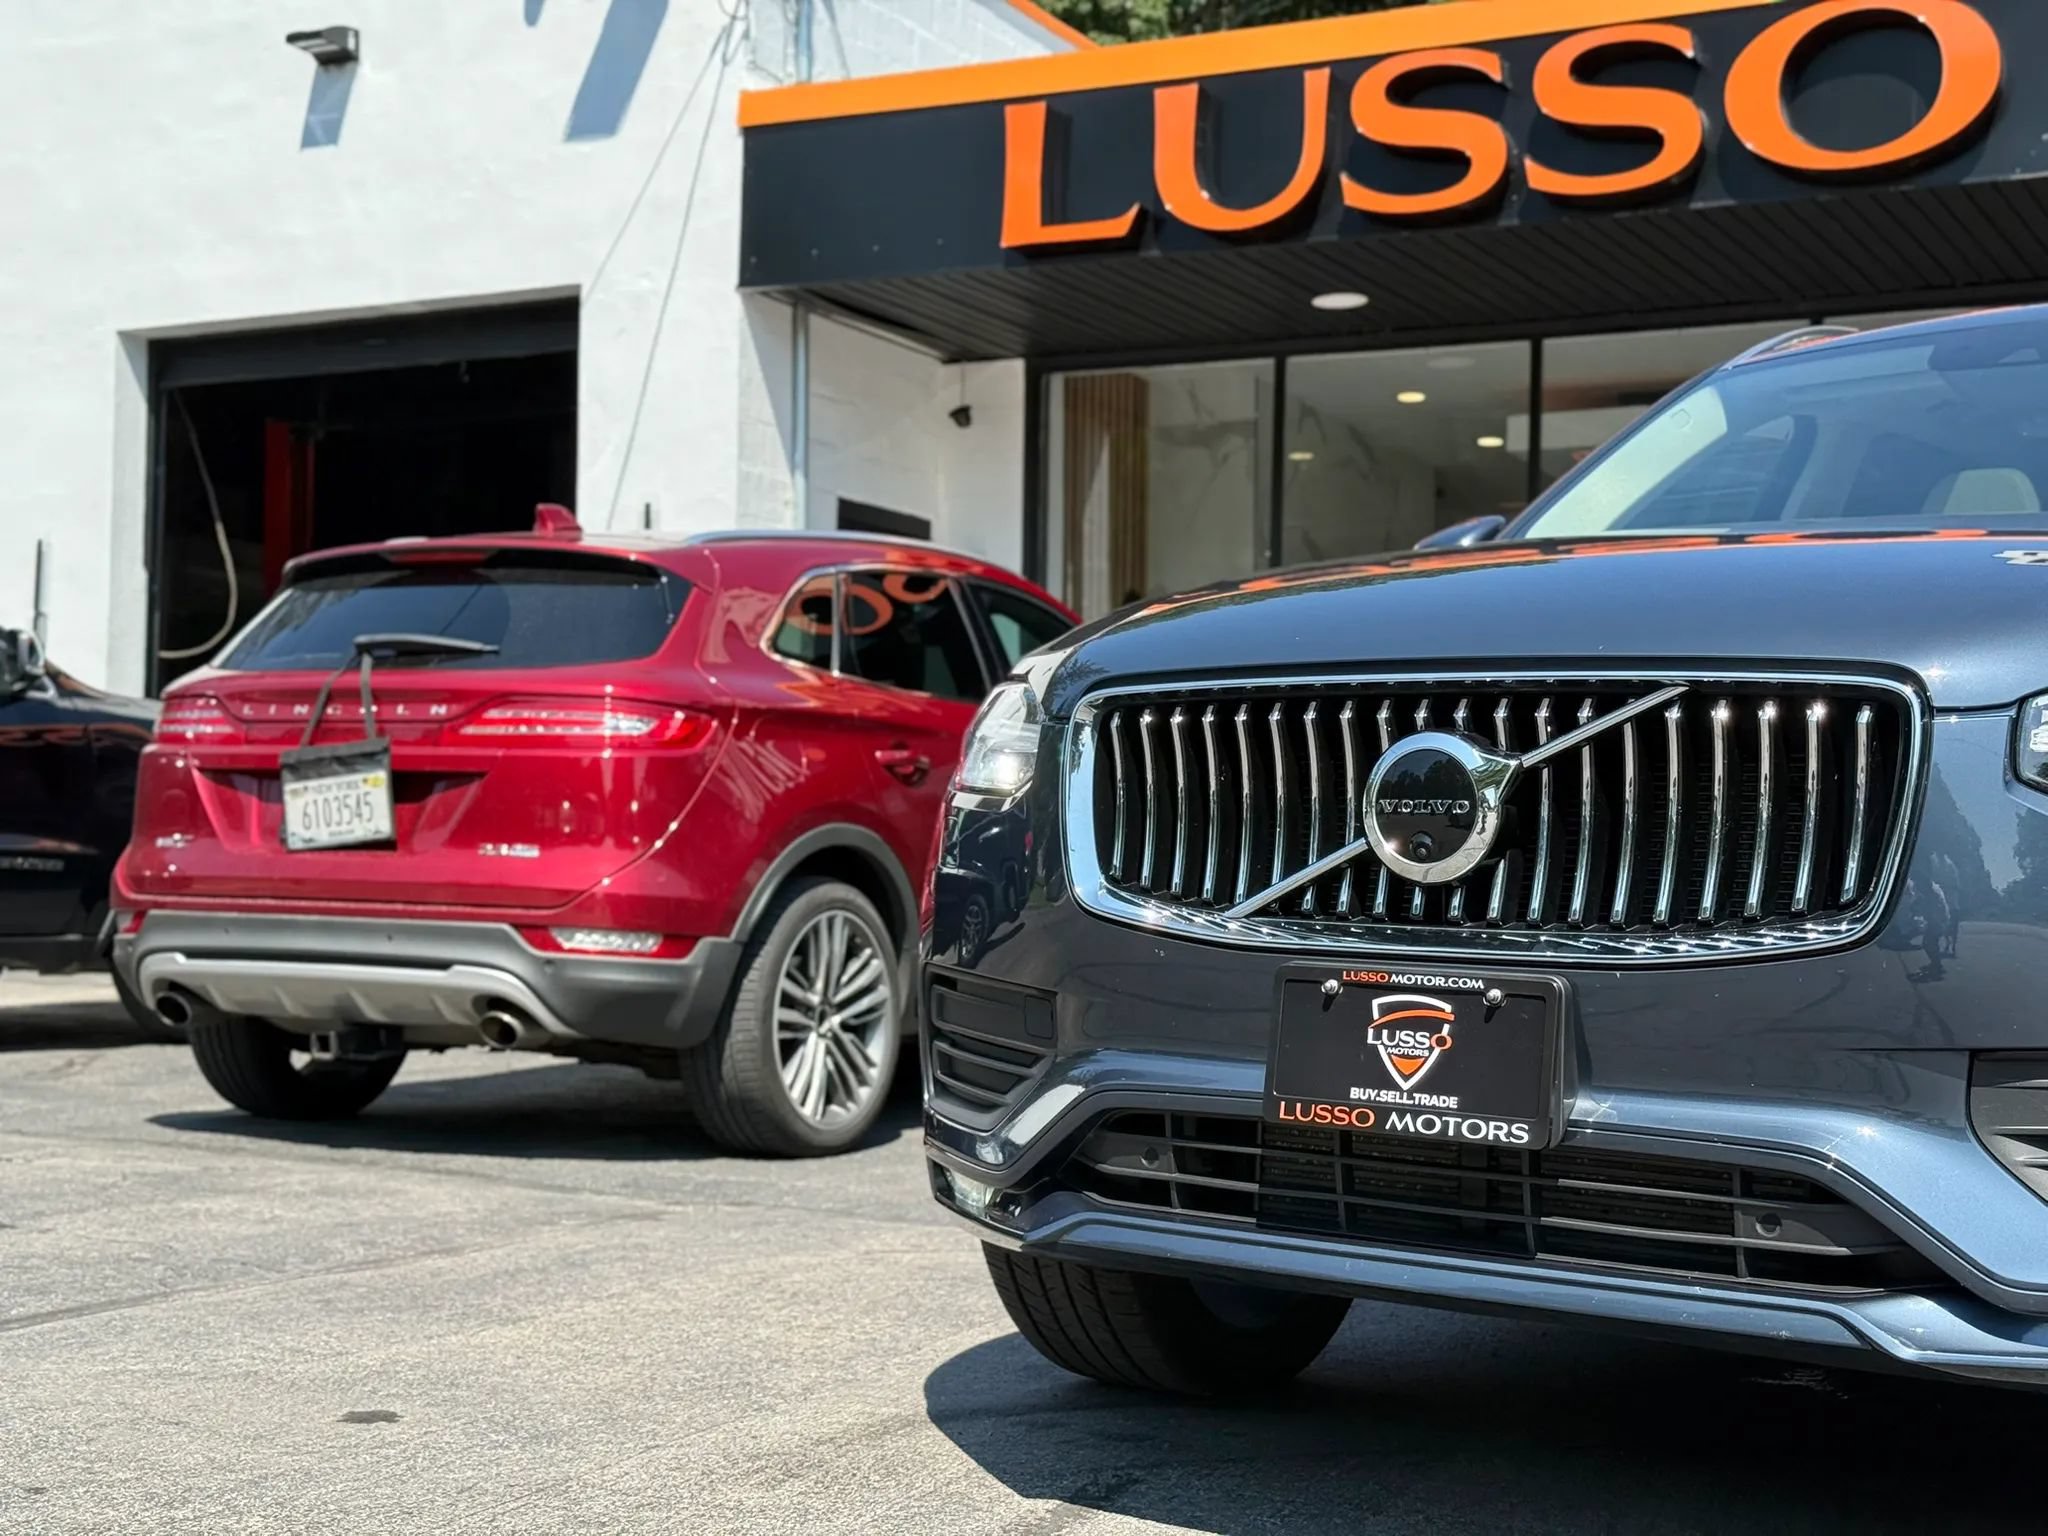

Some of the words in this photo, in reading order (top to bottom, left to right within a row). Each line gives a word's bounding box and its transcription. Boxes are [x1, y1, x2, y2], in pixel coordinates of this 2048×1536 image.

[1000, 0, 2002, 248] LUSSO
[302, 791, 374, 831] 6103545
[1379, 799, 1471, 814] VOLVO
[1367, 1027, 1453, 1050] LUSSO
[1386, 1047, 1430, 1057] MOTORS
[1279, 1101, 1376, 1128] LUSSO
[1385, 1111, 1530, 1144] MOTORS
